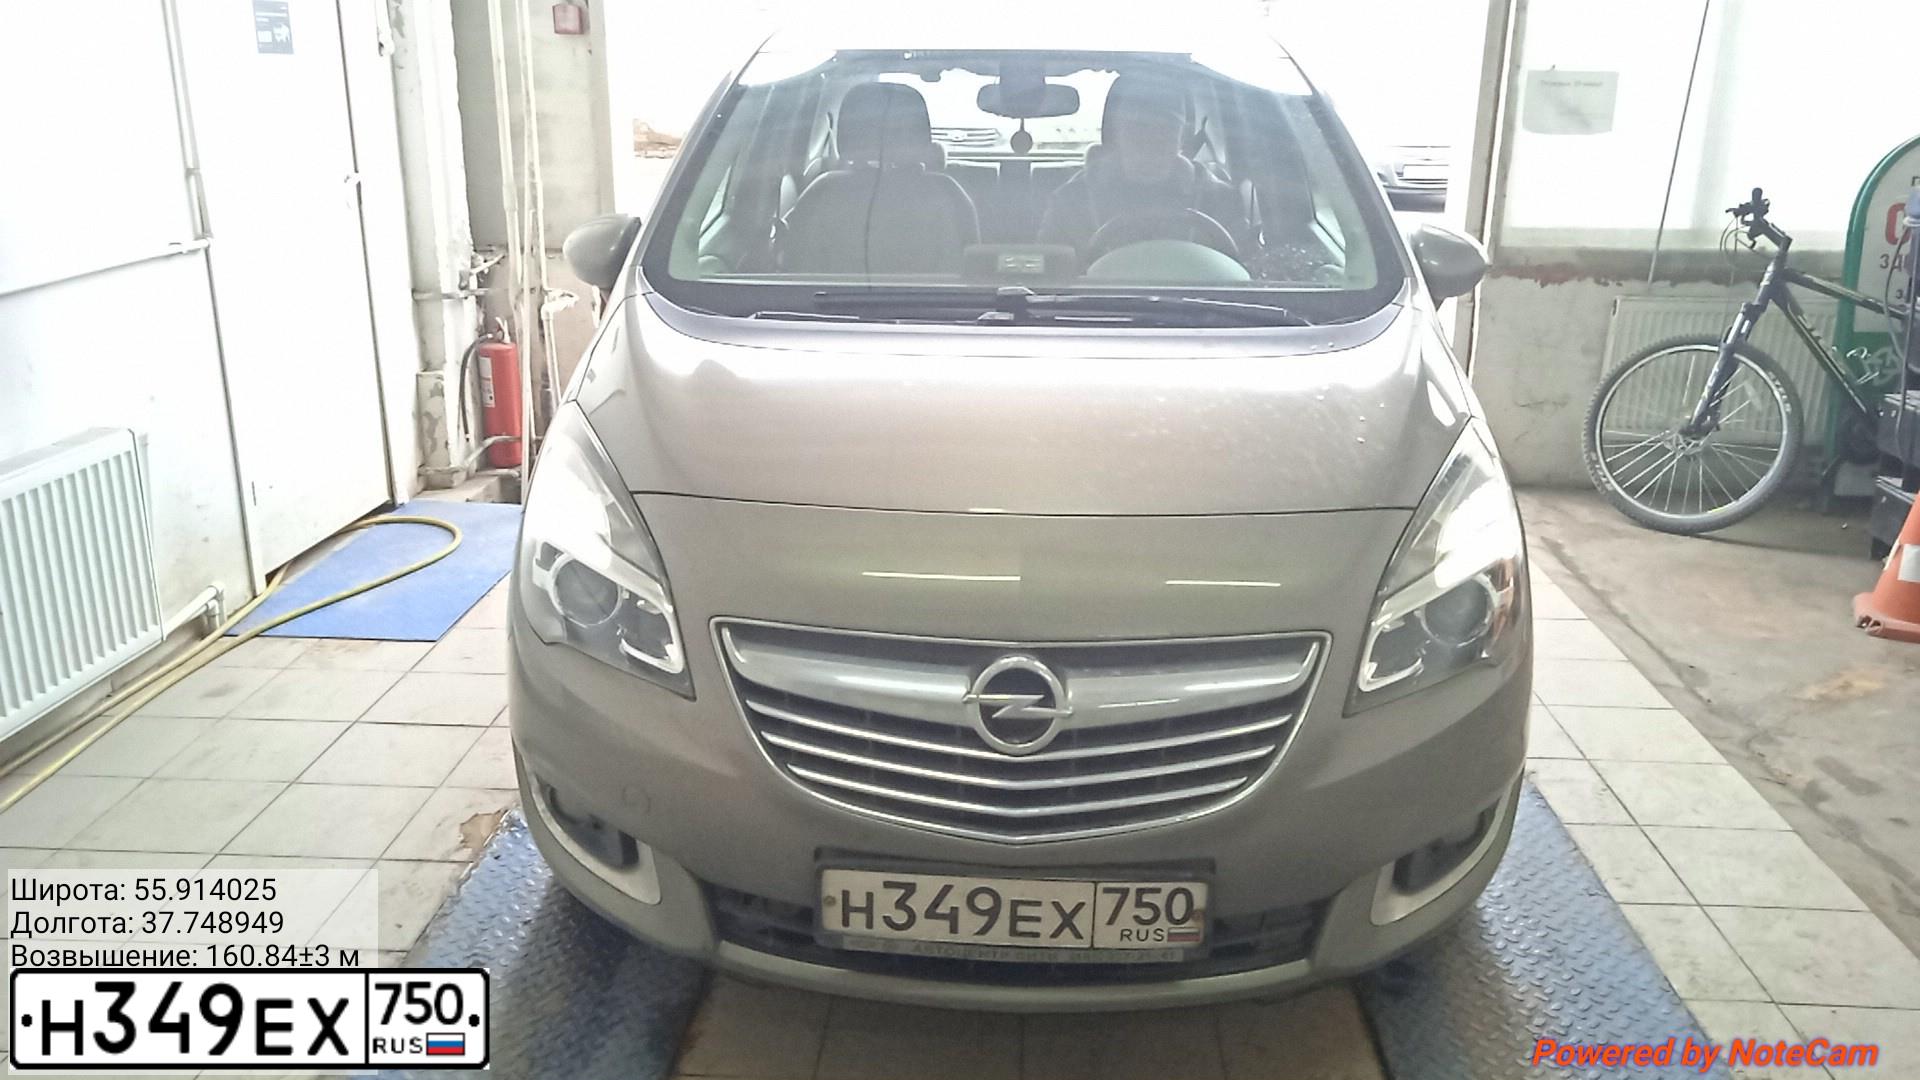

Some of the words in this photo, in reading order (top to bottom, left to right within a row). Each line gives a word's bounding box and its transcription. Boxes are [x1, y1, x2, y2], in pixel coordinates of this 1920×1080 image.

[841, 880, 1087, 940] Н349ЕХ
[1101, 886, 1194, 926] 750
[1119, 927, 1165, 943] RUS
